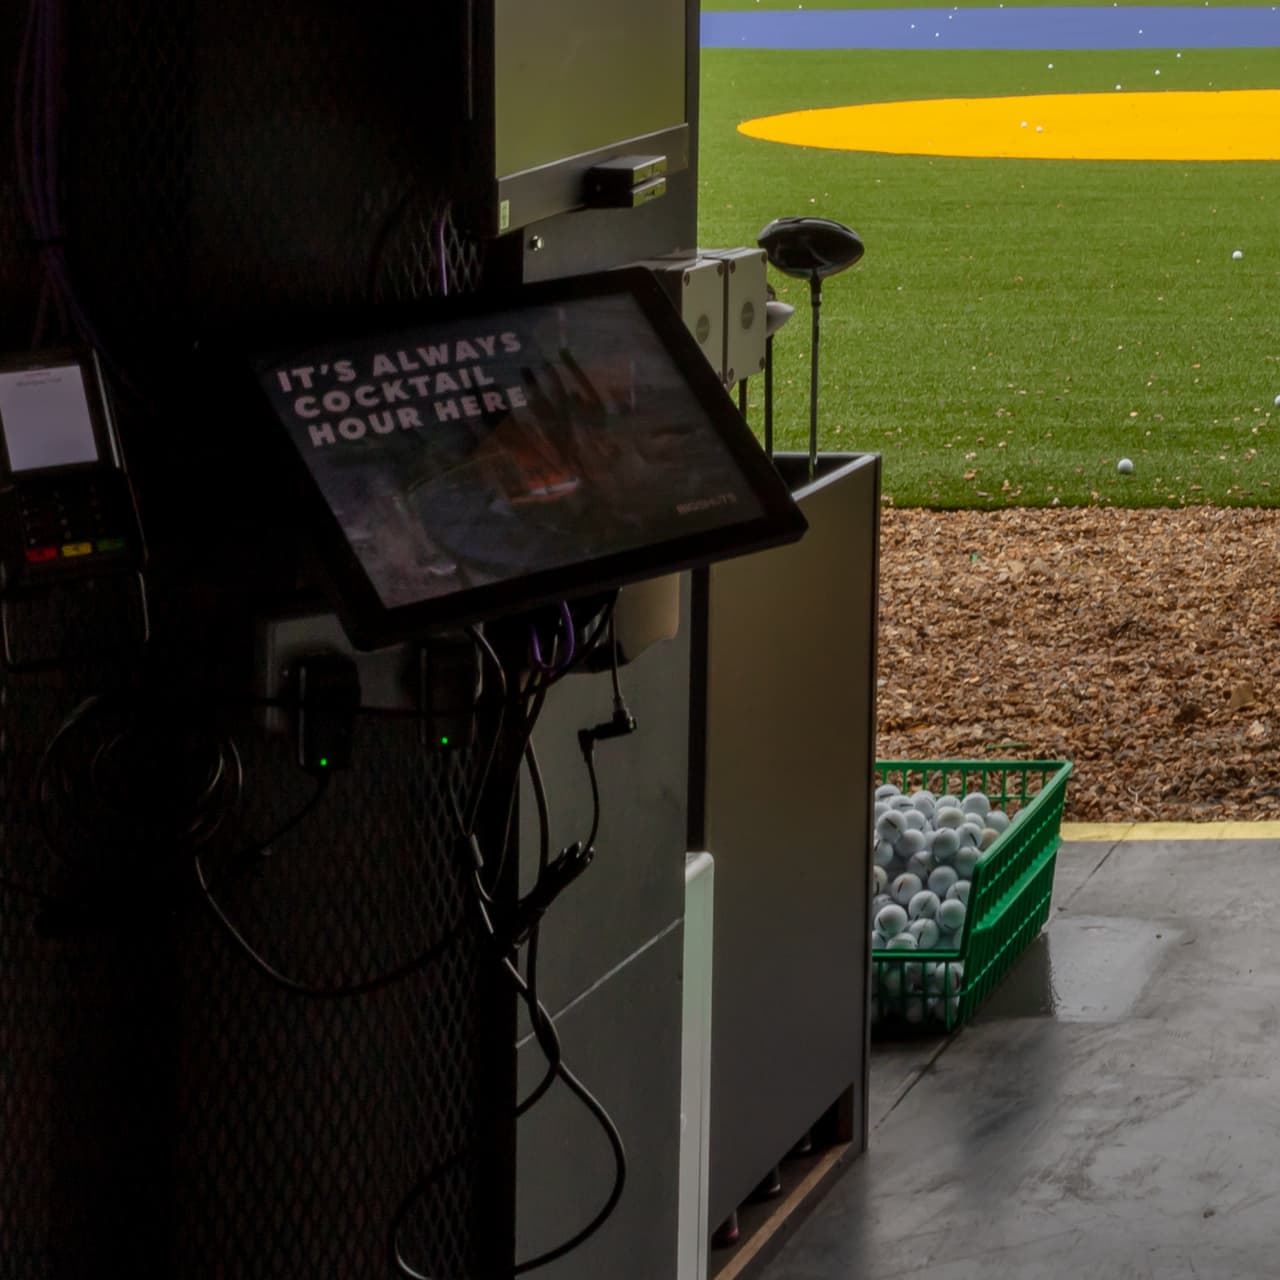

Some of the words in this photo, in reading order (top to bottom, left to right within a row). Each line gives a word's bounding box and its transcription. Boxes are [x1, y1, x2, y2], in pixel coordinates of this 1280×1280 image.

[277, 359, 357, 393] IT'S
[372, 331, 522, 377] ALWAYS
[294, 365, 495, 418] COCKTAIL
[308, 406, 423, 447] HOUR
[433, 386, 528, 422] HERE
